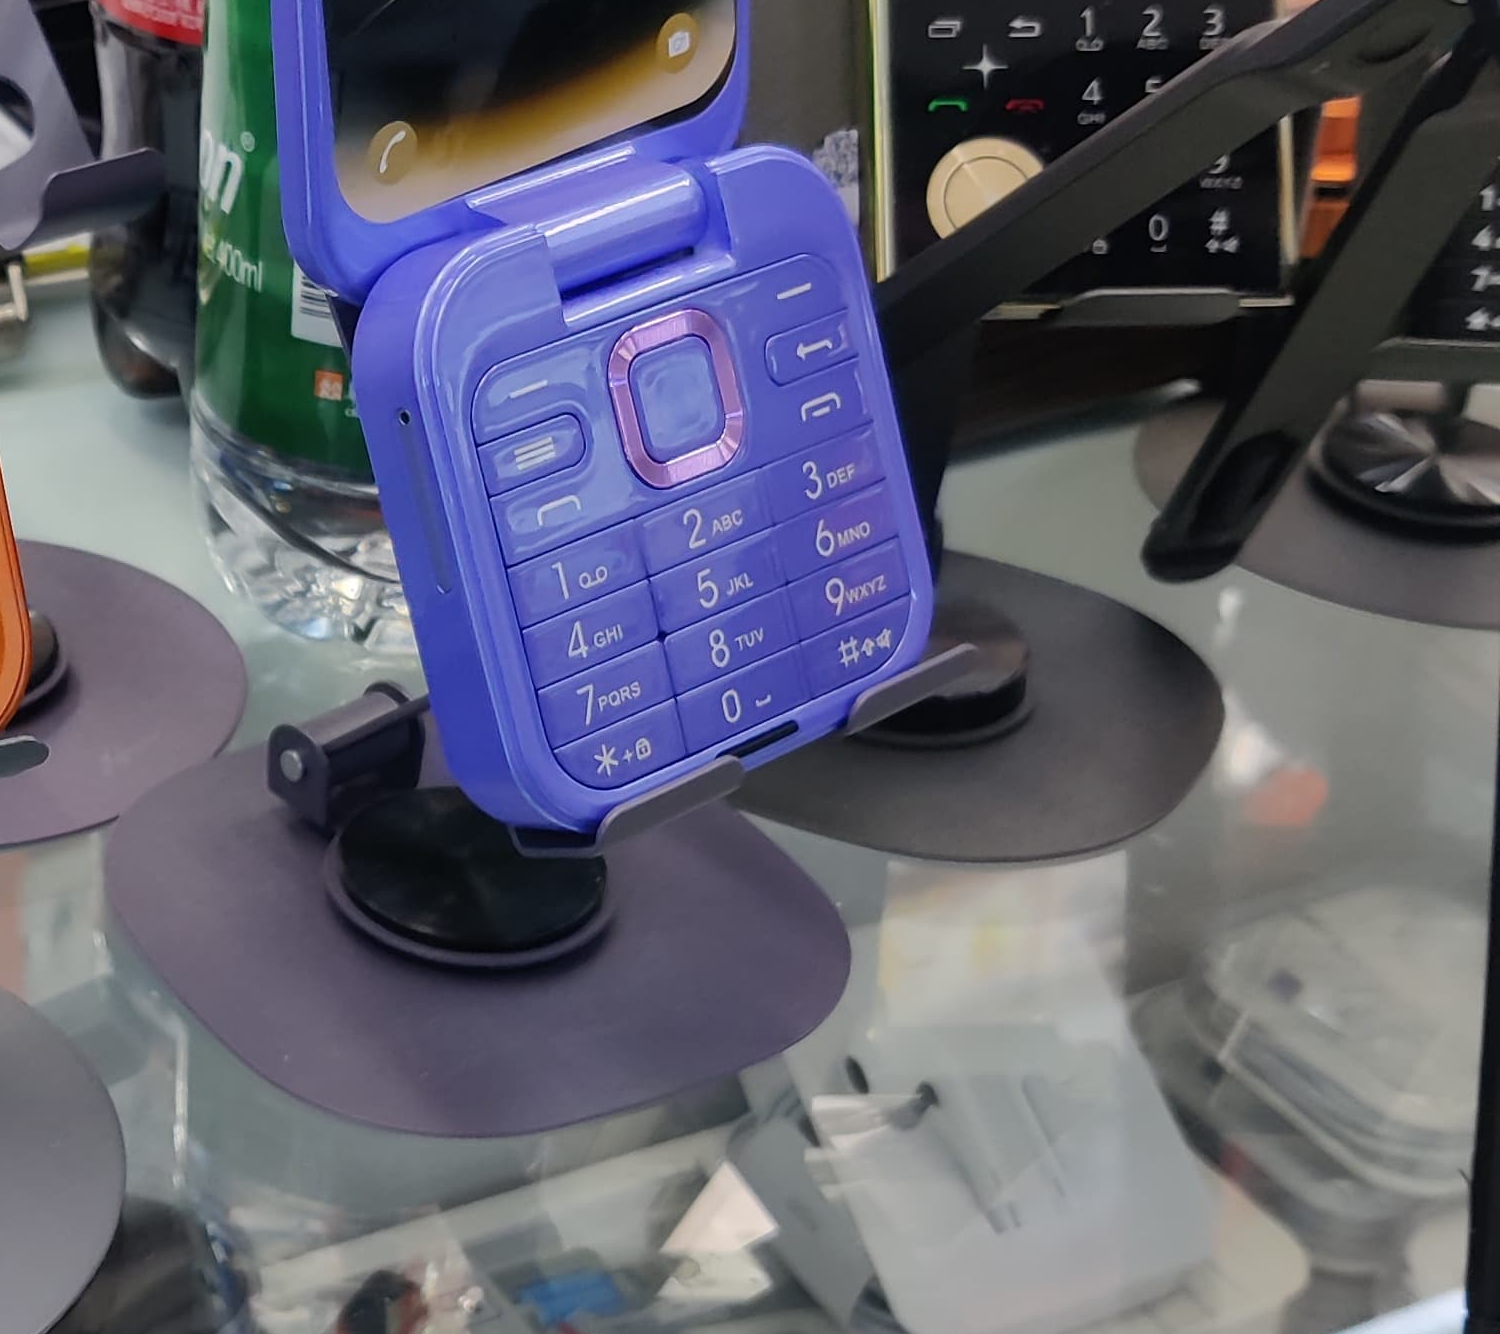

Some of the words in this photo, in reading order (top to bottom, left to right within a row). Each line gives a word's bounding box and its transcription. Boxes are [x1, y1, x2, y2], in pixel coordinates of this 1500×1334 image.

[1079, 5, 1095, 37] 1
[1141, 4, 1164, 37] 2
[1202, 5, 1225, 37] 3
[1081, 77, 1102, 105] 4
[1149, 213, 1169, 241] 0
[802, 460, 823, 500] 3
[826, 463, 856, 489] DEF
[683, 508, 707, 550] 2
[711, 509, 744, 537] ABC
[815, 518, 836, 557] 6
[837, 521, 871, 548] MNO
[551, 561, 570, 600] 1
[696, 568, 719, 609] 5
[725, 571, 754, 596] JKL
[825, 577, 846, 616] 9
[846, 575, 888, 605] WXYZ
[568, 620, 588, 658] 4
[593, 623, 624, 648] GHI
[708, 628, 730, 669] 8
[734, 627, 765, 651] TUV
[576, 683, 594, 726] 7
[598, 681, 642, 712] PQRS
[721, 689, 742, 724] 0
